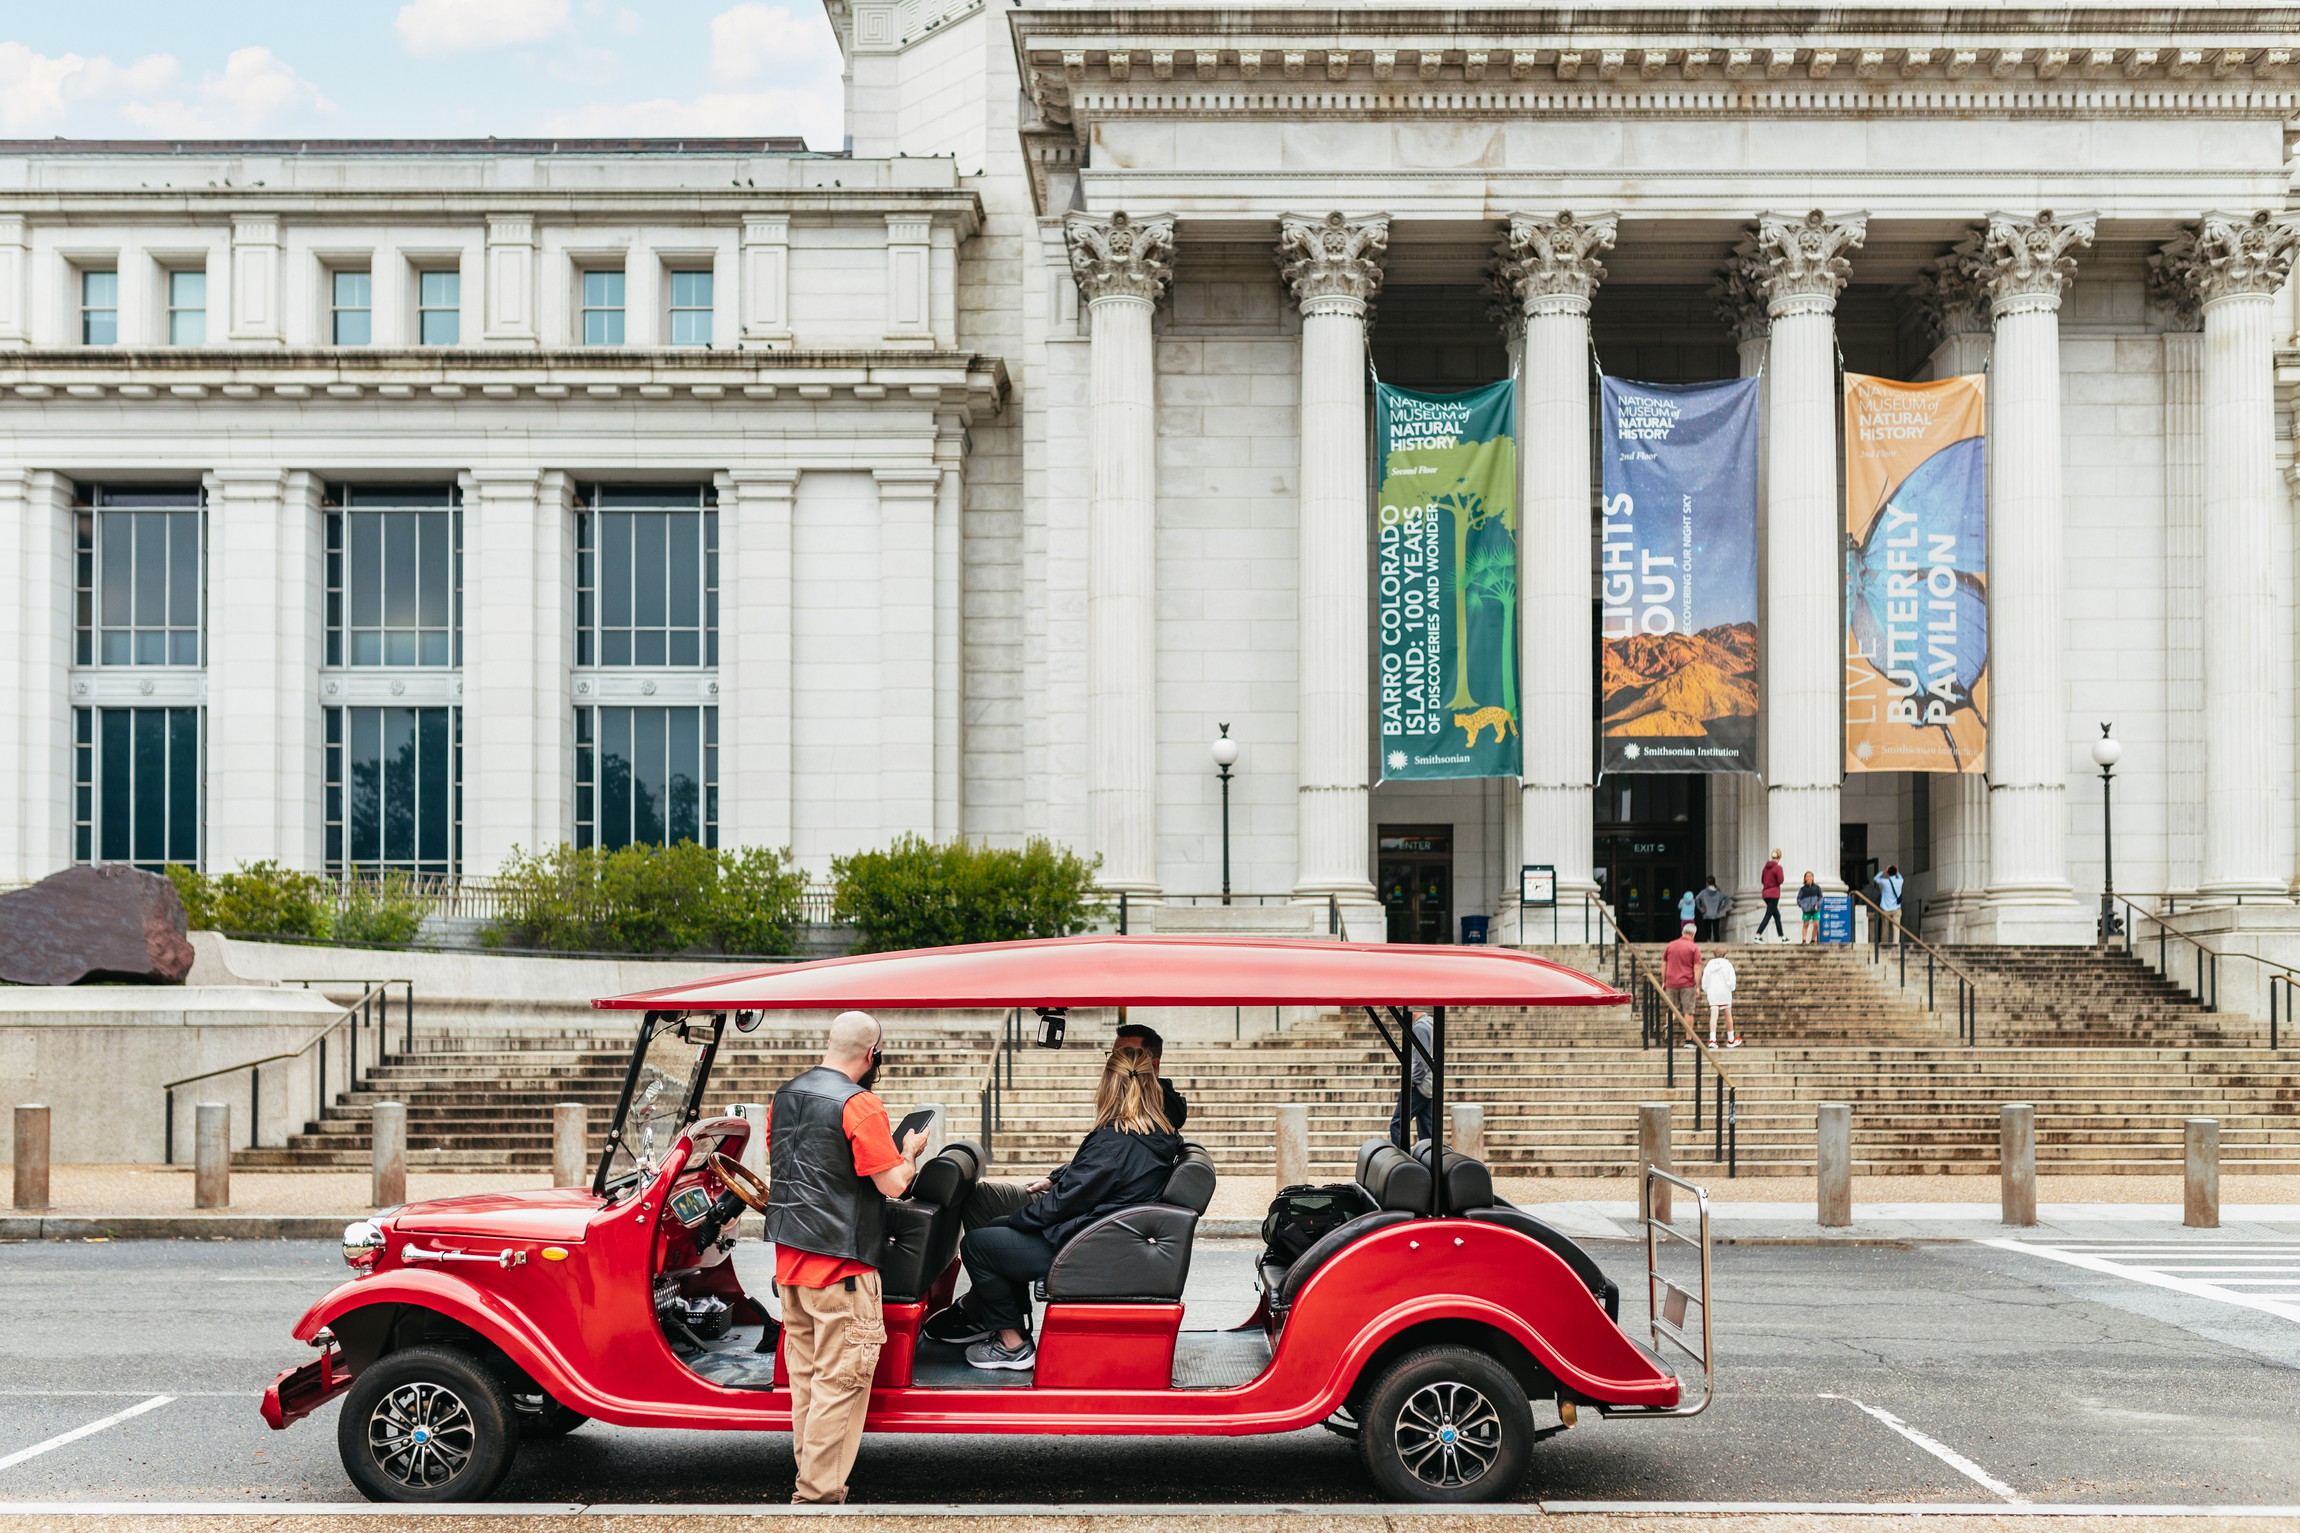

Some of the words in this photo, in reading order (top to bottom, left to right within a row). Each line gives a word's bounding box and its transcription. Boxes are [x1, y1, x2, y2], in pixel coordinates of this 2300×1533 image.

[1390, 396, 1467, 411] NATIONAL
[1618, 395, 1678, 409] NATIONAL
[1859, 397, 1926, 412] MUSEUM
[1928, 399, 1940, 415] of
[1390, 408, 1456, 423] MUSEUM
[1458, 408, 1473, 423] of
[1618, 406, 1670, 417] MUSEUM
[1671, 409, 1681, 420] of
[1859, 412, 1932, 426] NATURAL
[1390, 421, 1464, 437] NATURAL
[1619, 417, 1675, 428] NATURAL
[1619, 429, 1669, 440] HISTORY
[1860, 427, 1925, 441] HISTORY
[1390, 436, 1457, 452] HISTORY
[1619, 452, 1634, 461] 2nd
[1637, 451, 1657, 460] Floor
[1391, 467, 1417, 476] Second
[1418, 465, 1438, 474] Floor
[1683, 493, 1692, 514] SKY
[1426, 503, 1439, 572] WONDER
[1683, 516, 1692, 547] NIGHT
[1403, 506, 1424, 584] YEARS
[1602, 492, 1634, 638] LIGHTS
[1683, 547, 1692, 571] OUR
[1380, 505, 1401, 646] COLORADO
[1427, 576, 1439, 610] AND
[1641, 549, 1675, 636] OUT
[1404, 590, 1424, 632] 100
[1887, 502, 1918, 724] BUTTERFLY
[1928, 533, 1957, 725] PAVILION
[1427, 614, 1440, 709] DISCOVERIES
[1405, 641, 1425, 735] ISLAND:
[1846, 637, 1876, 725] LIVE
[1382, 653, 1402, 735] BARRO
[1428, 713, 1440, 734] OF
[1643, 746, 1696, 756] Smithsonian
[1698, 747, 1739, 757] Institution
[1881, 744, 1935, 755] Smithsonian
[1414, 753, 1470, 765] Smithsonian
[1399, 841, 1431, 850] ENTER
[1634, 844, 1655, 852] EXIT
